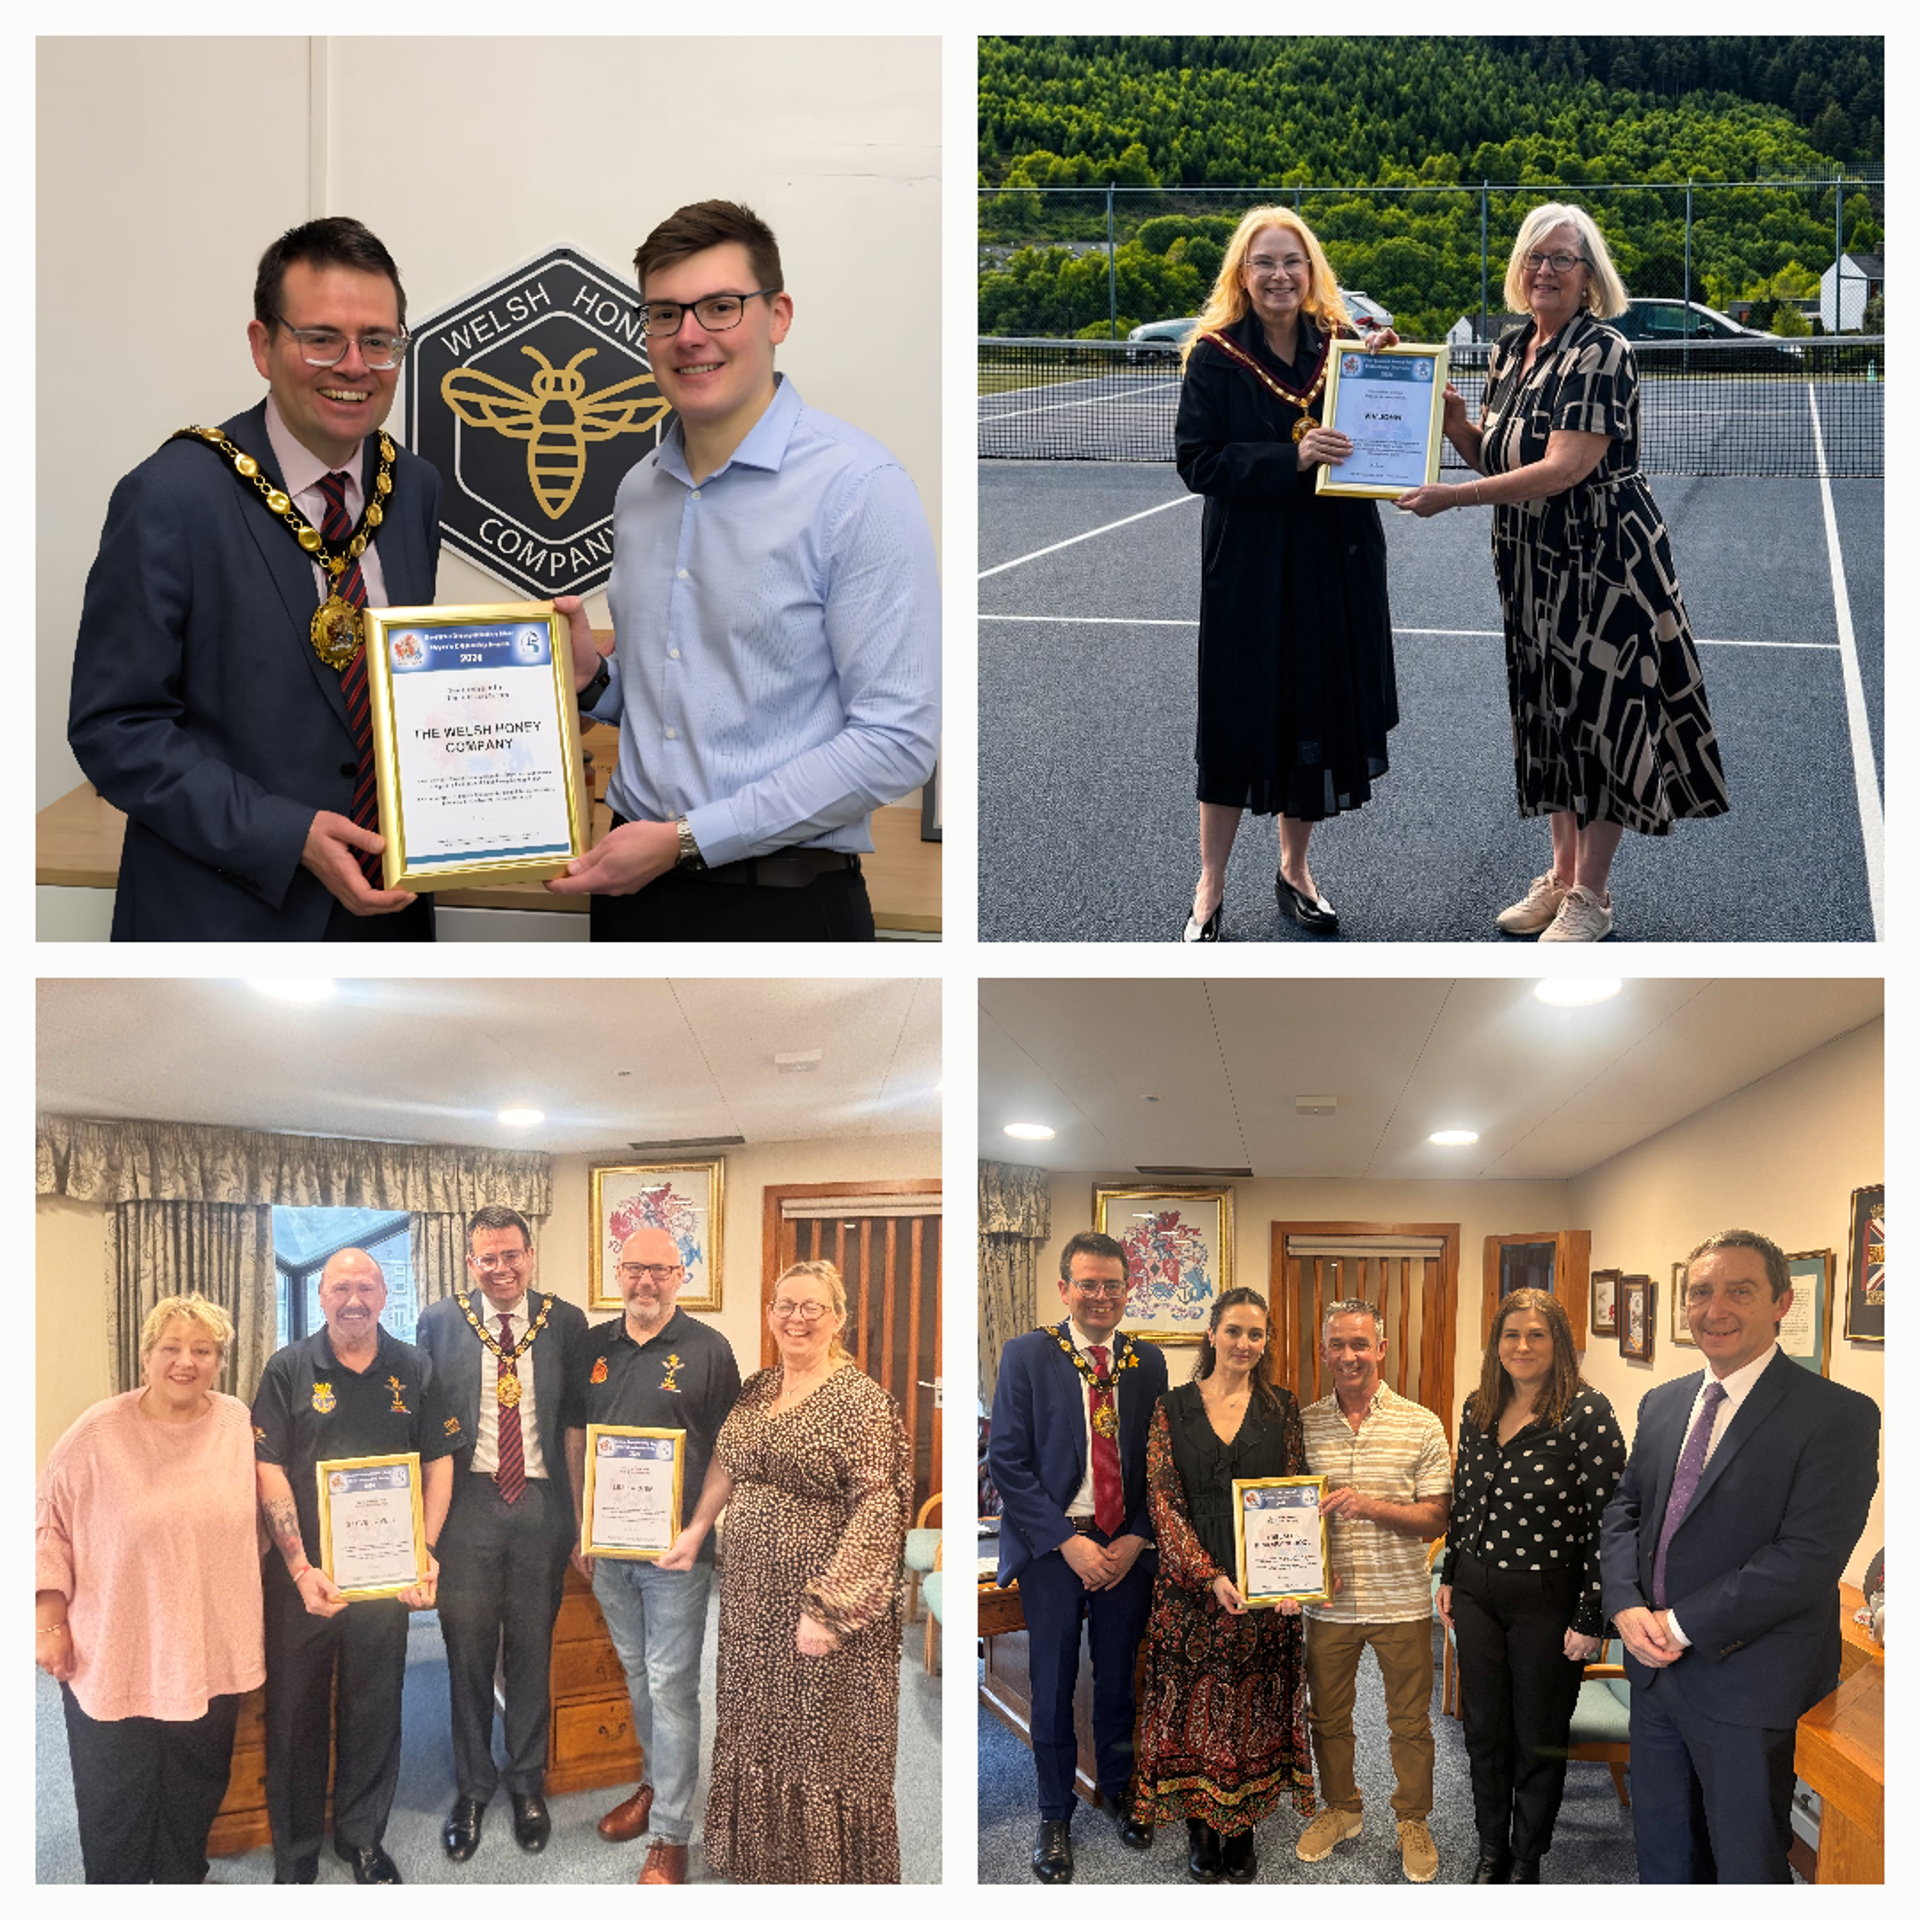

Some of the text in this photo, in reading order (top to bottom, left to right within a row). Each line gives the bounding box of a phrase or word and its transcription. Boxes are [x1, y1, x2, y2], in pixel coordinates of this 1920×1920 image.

[440, 282, 648, 356] WELSH HON
[479, 519, 614, 577] COMPAN
[444, 724, 492, 738] WELSH
[495, 721, 541, 733] HONEY
[446, 738, 513, 753] COMPANY
